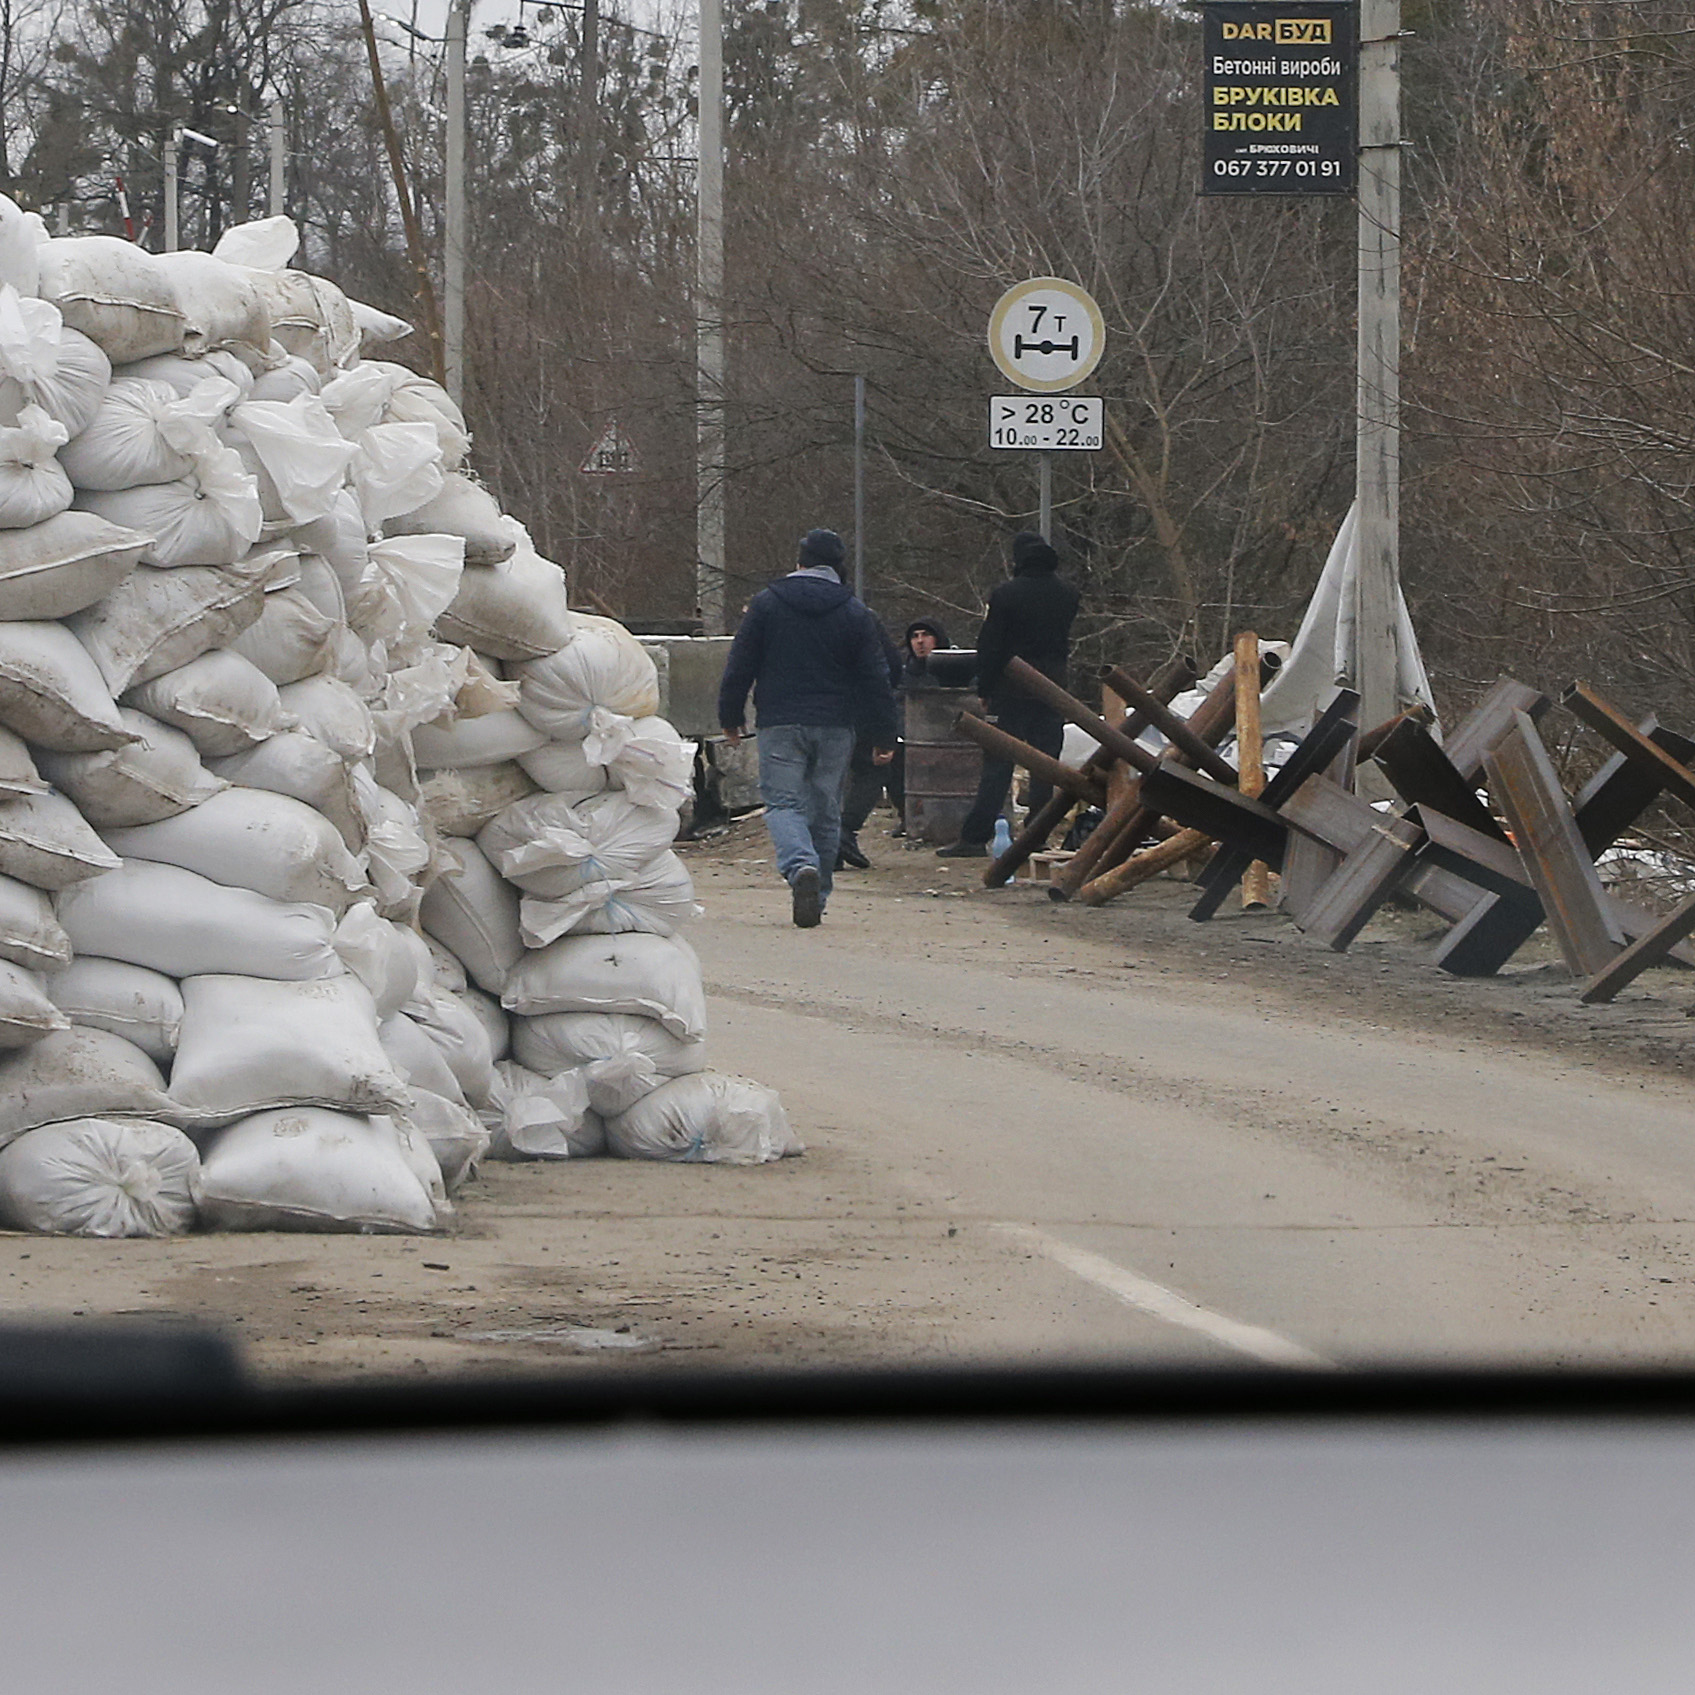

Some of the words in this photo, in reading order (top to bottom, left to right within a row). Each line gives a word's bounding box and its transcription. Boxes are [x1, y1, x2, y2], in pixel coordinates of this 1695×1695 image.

[1222, 22, 1273, 41] DAR
[1279, 23, 1327, 42] БУД
[1213, 56, 1276, 76] Бетонні
[1280, 56, 1341, 79] вироби
[1213, 86, 1340, 106] БРУКІВКА
[1213, 112, 1302, 132] БЛОКИ
[1213, 159, 1252, 176] 067
[1256, 160, 1292, 177] 377
[1295, 160, 1316, 177] 01
[1320, 160, 1340, 177] 91
[1028, 305, 1048, 334] 7
[1025, 403, 1054, 424] 28
[994, 428, 1038, 446] 10.00
[1055, 428, 1100, 447] 22.00
